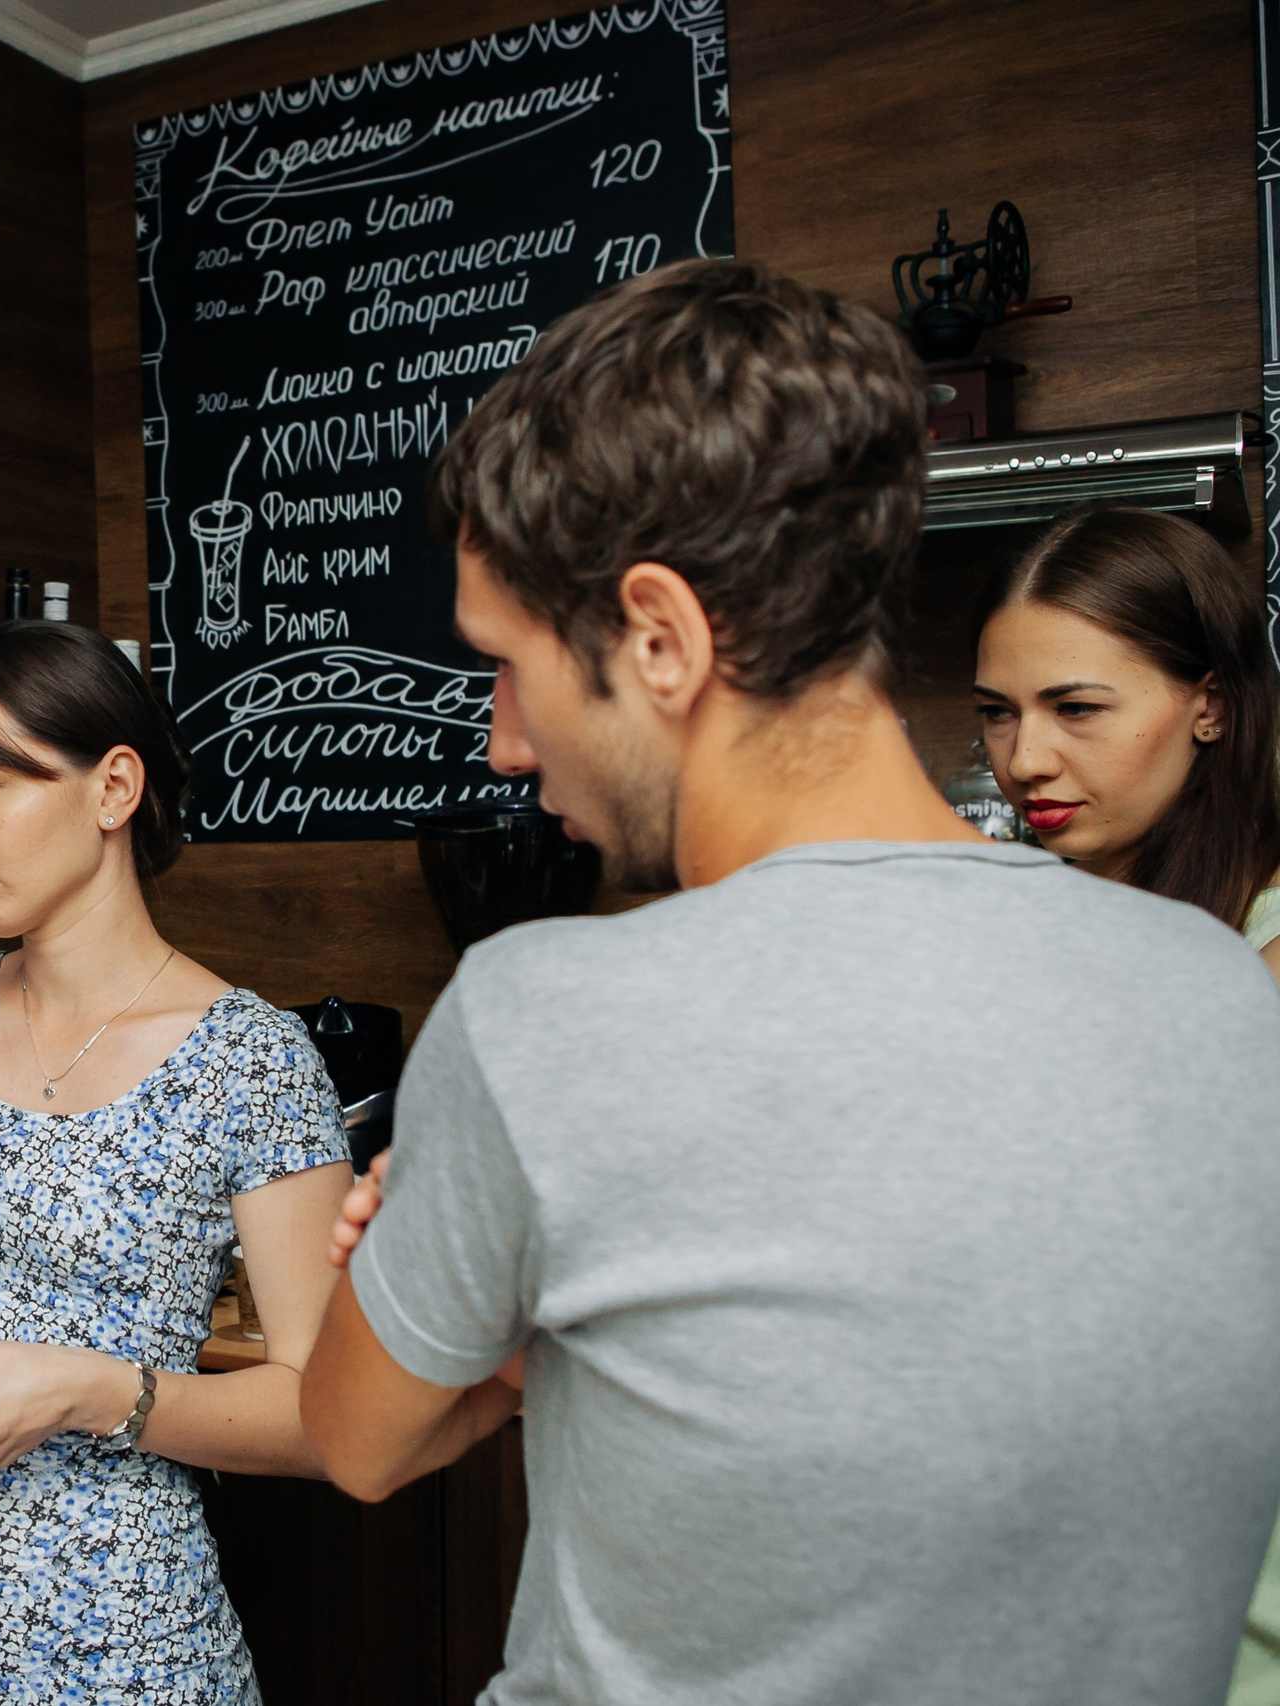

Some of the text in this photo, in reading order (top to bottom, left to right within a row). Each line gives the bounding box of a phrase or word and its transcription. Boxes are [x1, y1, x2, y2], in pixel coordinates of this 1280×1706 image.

[186, 72, 619, 216] Кофейные напитки:
[589, 139, 662, 189] 120
[246, 217, 352, 260] Флет
[366, 194, 454, 236] Уайт
[254, 270, 326, 316] Раф
[345, 219, 577, 293] классический
[594, 233, 661, 284] 170
[349, 271, 530, 335] авторский
[256, 366, 353, 410] Мокко
[396, 325, 544, 383] шоколад
[261, 386, 448, 481] ХОЛОДНЫЙ
[224, 721, 444, 777] Сиропы
[201, 777, 529, 835] Маршмел
[951, 799, 1015, 818] smine
